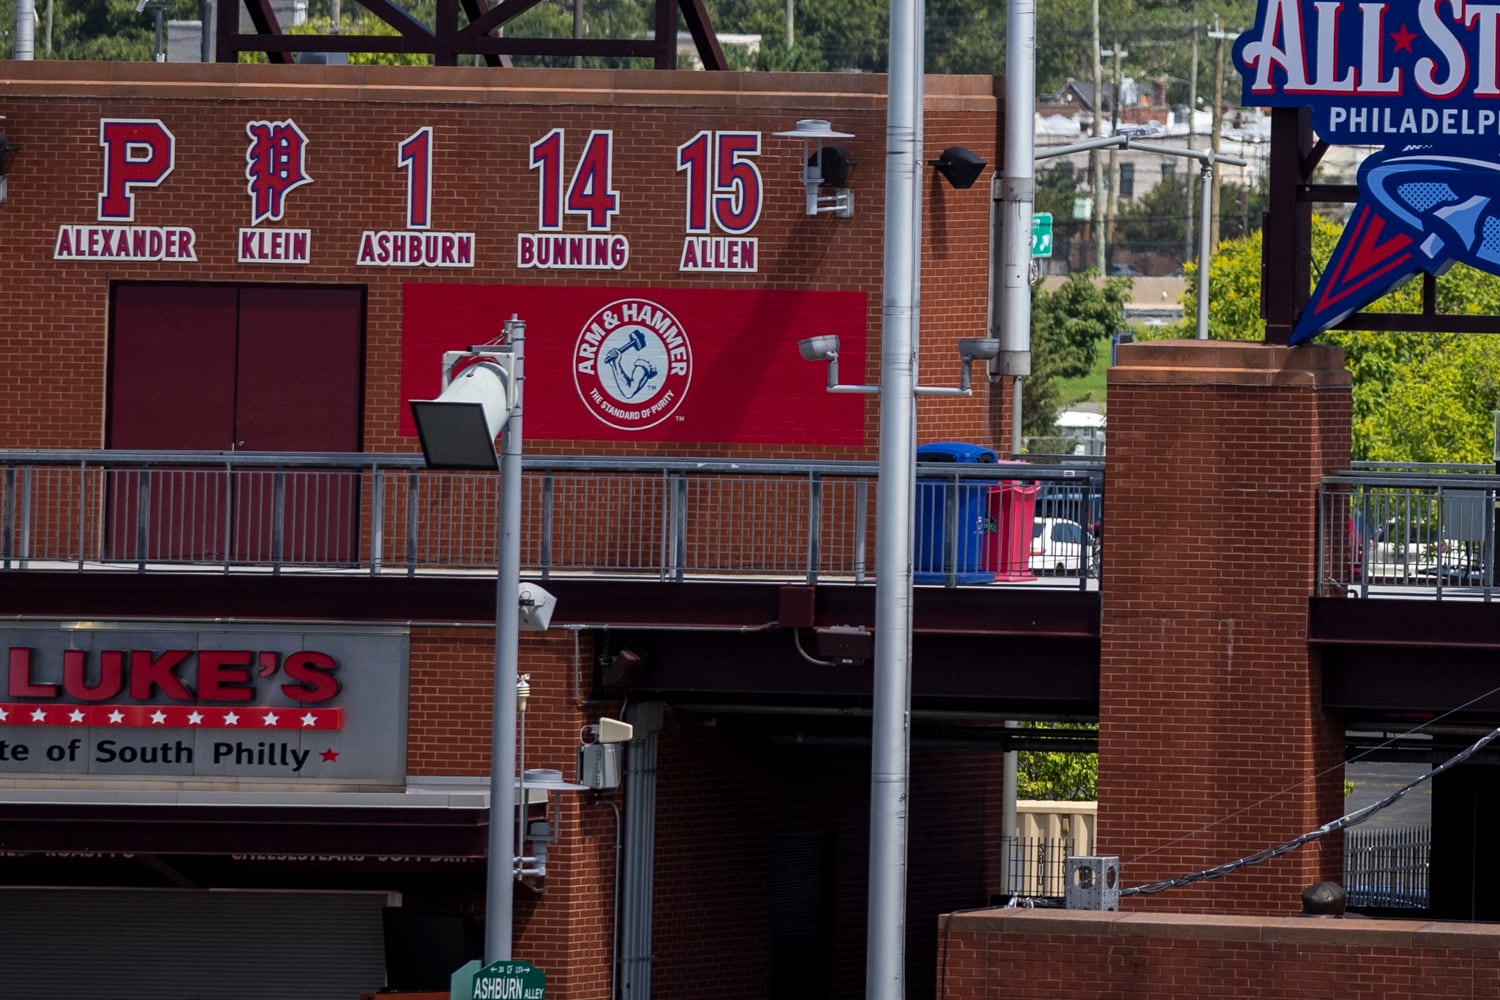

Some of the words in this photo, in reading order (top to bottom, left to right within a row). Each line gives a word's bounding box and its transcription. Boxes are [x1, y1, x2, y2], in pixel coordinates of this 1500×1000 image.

[99, 118, 175, 221] P
[399, 127, 432, 229] 1
[529, 127, 620, 231] 14
[677, 130, 762, 234] 15
[56, 228, 195, 260] ALEXANDER
[240, 229, 309, 261] KLEIN
[358, 232, 473, 265] ASHBURN
[518, 236, 628, 268] BUNNING
[681, 238, 757, 270] ALLEN
[578, 321, 607, 376] ARM
[602, 310, 621, 330] &
[621, 303, 688, 377] HAMMER
[588, 387, 603, 405] THE
[600, 399, 641, 421] STANDARD
[641, 408, 653, 419] OF
[652, 389, 676, 414] PURITY
[46, 738, 82, 763] of
[95, 739, 194, 765] South
[212, 741, 312, 773] Philly
[474, 978, 522, 999] ASHBURN
[523, 988, 544, 999] ALLEY
